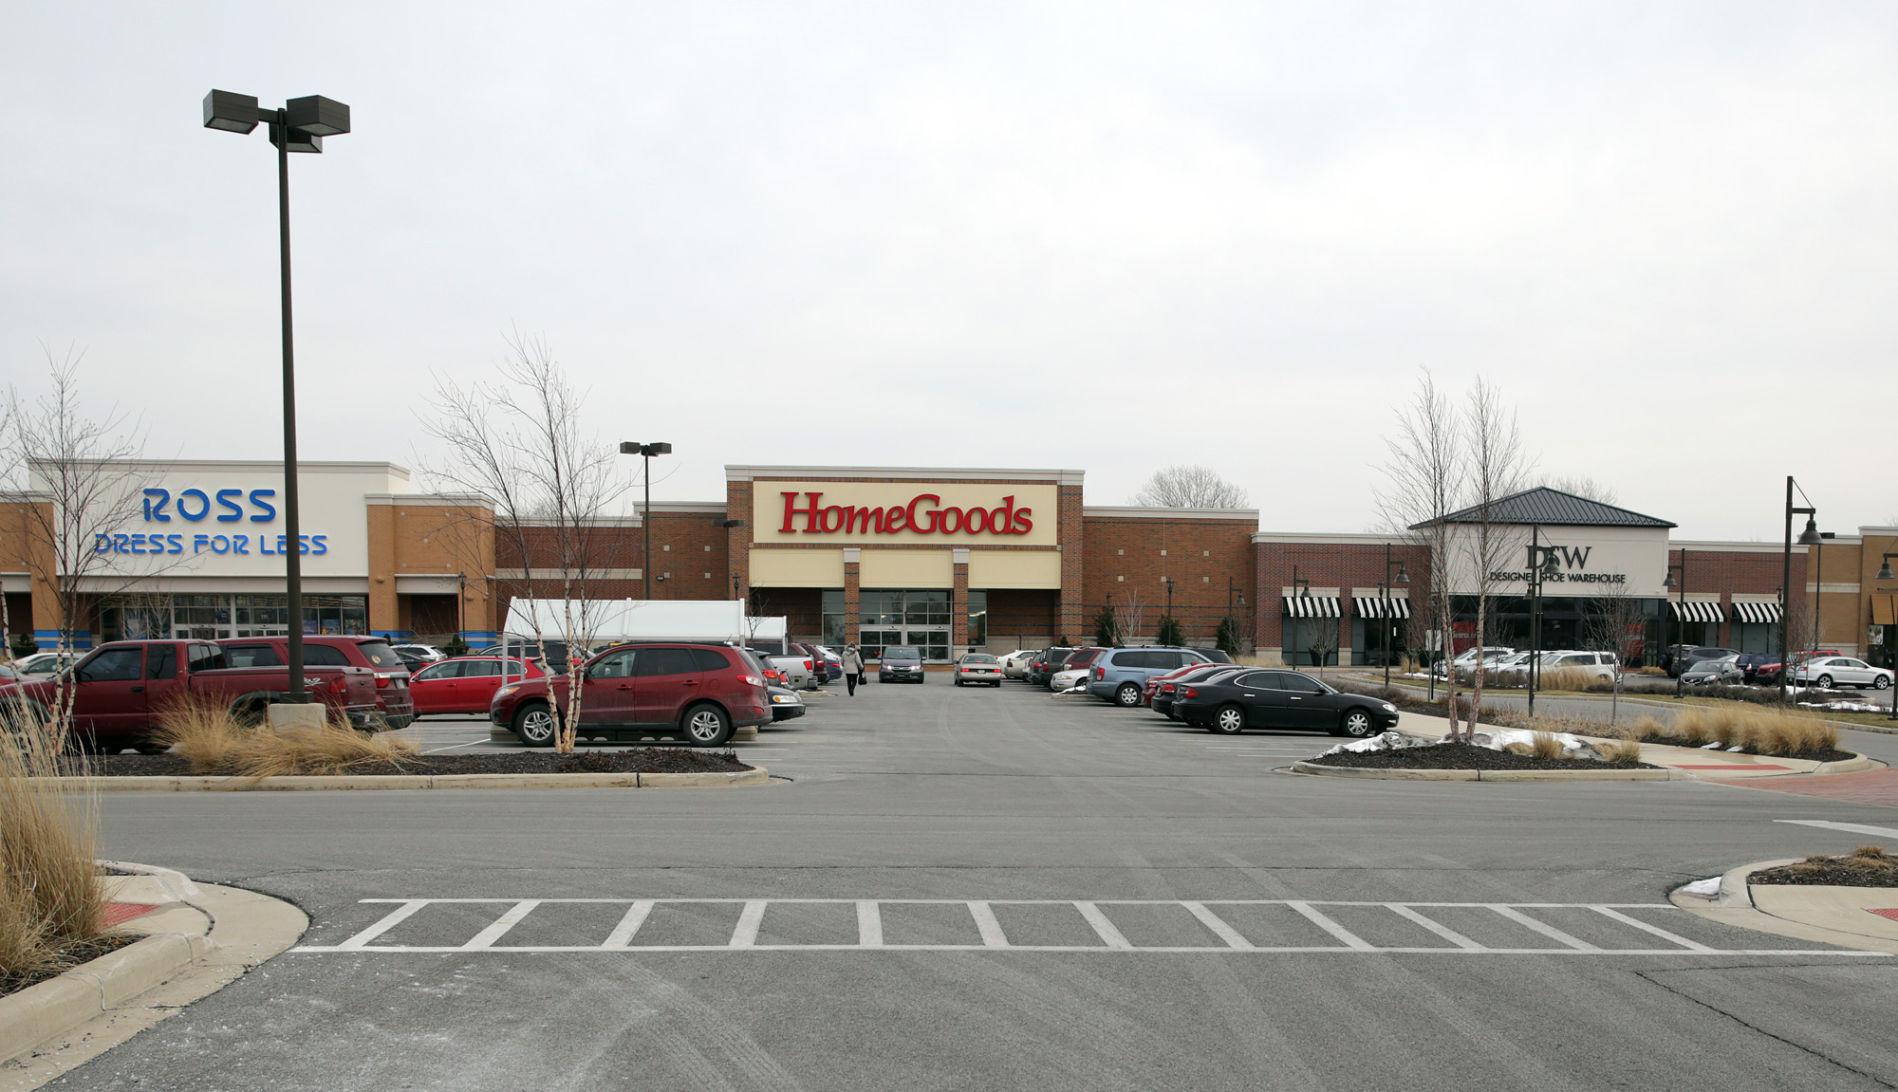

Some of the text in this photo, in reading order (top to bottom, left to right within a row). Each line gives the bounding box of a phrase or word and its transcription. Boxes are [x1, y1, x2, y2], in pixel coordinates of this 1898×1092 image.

[143, 488, 276, 522] ROSS
[778, 491, 1033, 536] HomeGoods
[95, 533, 183, 554] DRESS
[194, 534, 249, 555] FOR
[1490, 572, 1626, 583] DESIGNE SHOE WAREHOUSE
